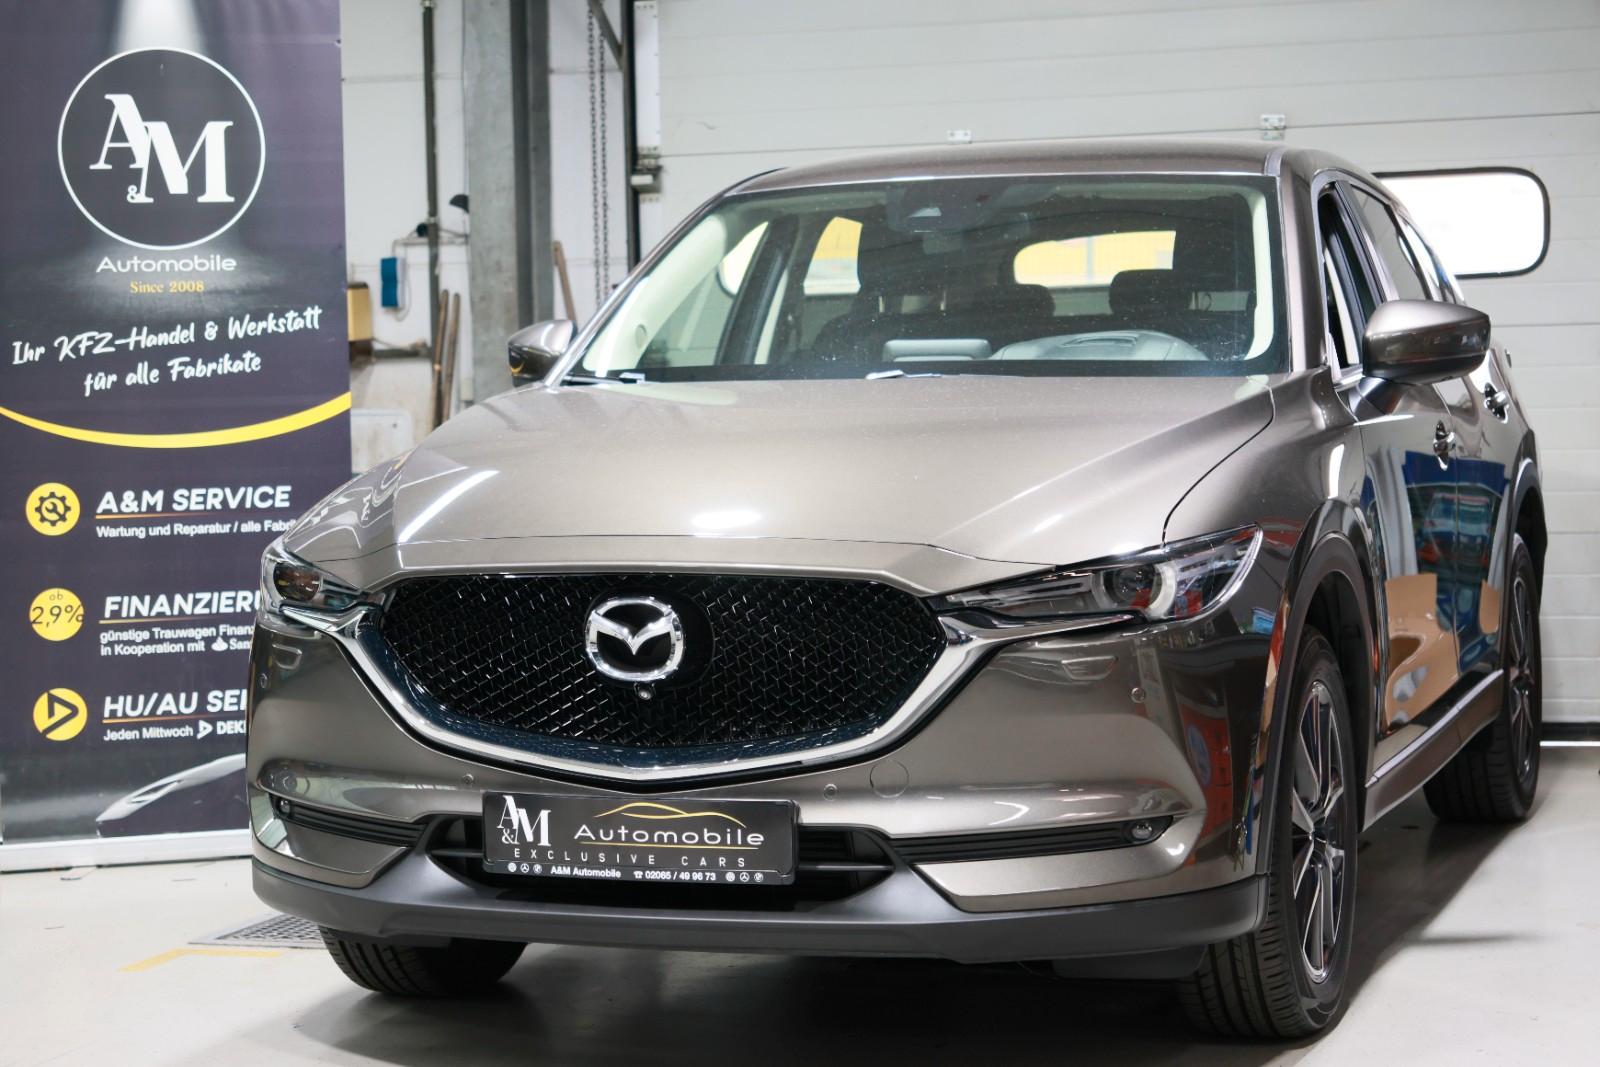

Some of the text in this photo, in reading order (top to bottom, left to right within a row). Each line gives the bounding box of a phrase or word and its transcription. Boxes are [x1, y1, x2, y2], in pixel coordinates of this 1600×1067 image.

[96, 255, 237, 273] Automobile
[130, 280, 204, 294] Since 2008
[11, 305, 322, 365] Ihr KFZ-Handel & Werkstatt
[84, 350, 262, 397] für alle Fabrikate
[96, 485, 292, 514] A&M SERVICE
[96, 525, 146, 539] Wartung
[149, 524, 171, 536] und
[174, 521, 232, 536] Reparatur
[240, 520, 262, 533] alle
[31, 604, 85, 628] 2,9%
[100, 629, 150, 644] günstige
[152, 626, 217, 640] Trauwagen
[100, 644, 112, 656] in
[114, 642, 184, 657] Kooperation
[187, 640, 206, 652] mit
[104, 692, 198, 717] HU/AU
[103, 720, 247, 741] Jeden Mittwoch DEK
[574, 824, 765, 846] Automobile
[514, 848, 746, 868] EXCLUSIVE CARS
[550, 866, 571, 876] A&M
[572, 867, 622, 879] Automobile
[645, 871, 672, 881] 02065
[679, 872, 692, 882] 49
[692, 872, 704, 882] 96
[705, 873, 717, 883] 73
